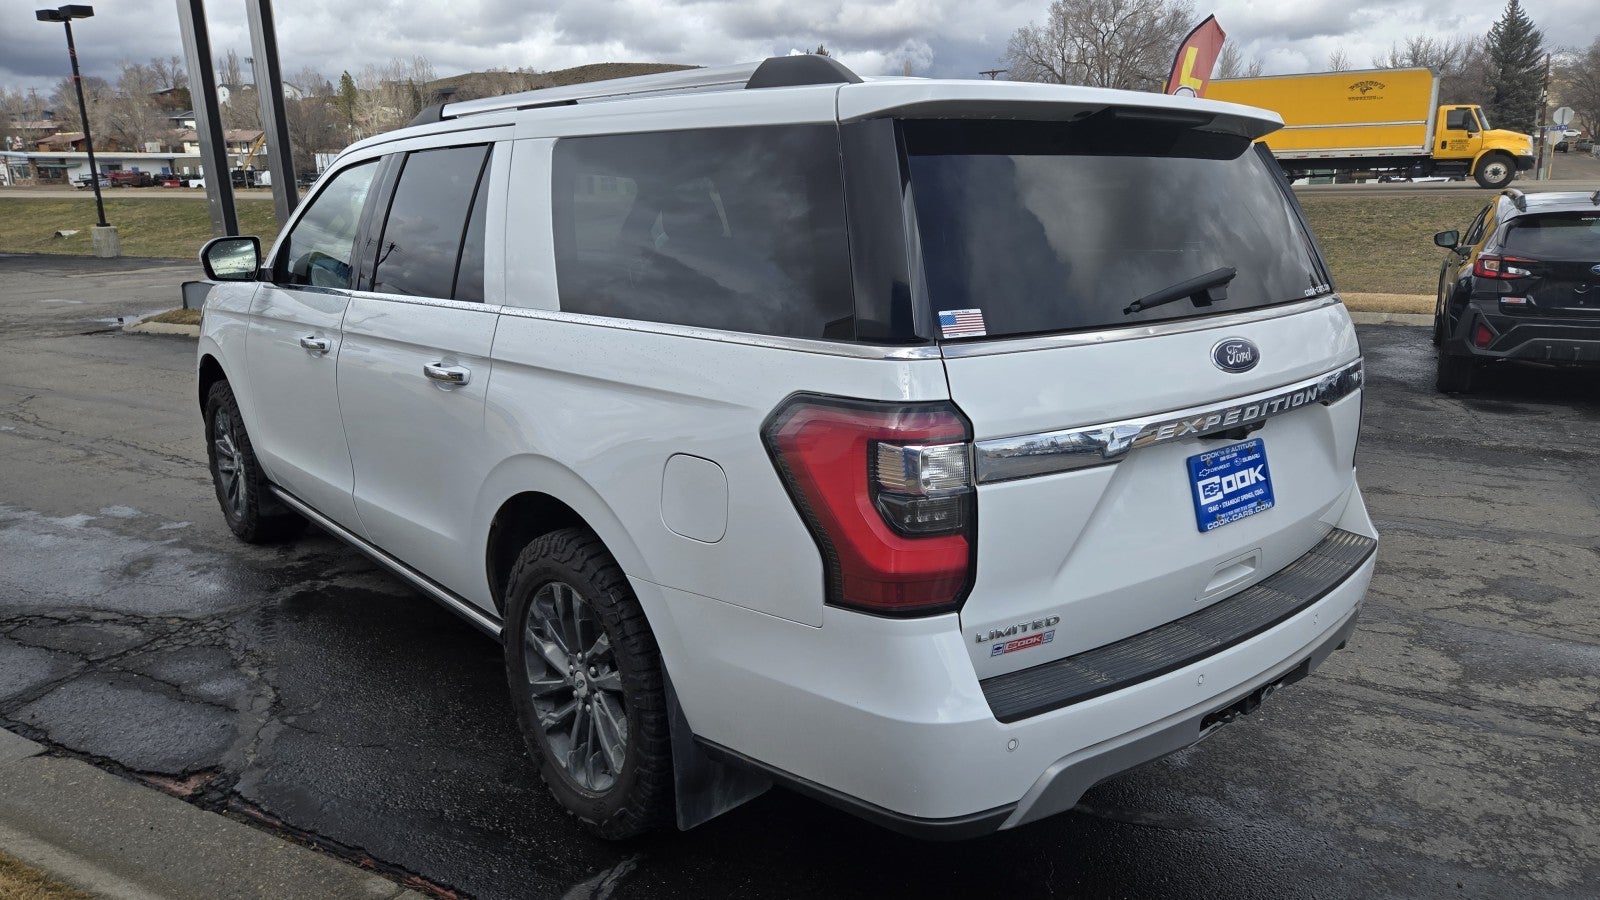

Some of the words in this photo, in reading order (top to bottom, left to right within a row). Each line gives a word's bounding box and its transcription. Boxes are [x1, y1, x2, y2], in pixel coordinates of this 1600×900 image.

[1226, 344, 1253, 365] Ford
[1154, 387, 1318, 441] EXPEDITION
[1230, 440, 1257, 453] ALTITUDE
[1242, 452, 1261, 463] SUBARU
[1197, 463, 1266, 506] COOK
[1207, 501, 1273, 530] COOK-CARS.COM
[976, 615, 1060, 643] LIMITED
[1005, 636, 1042, 650] COOK
